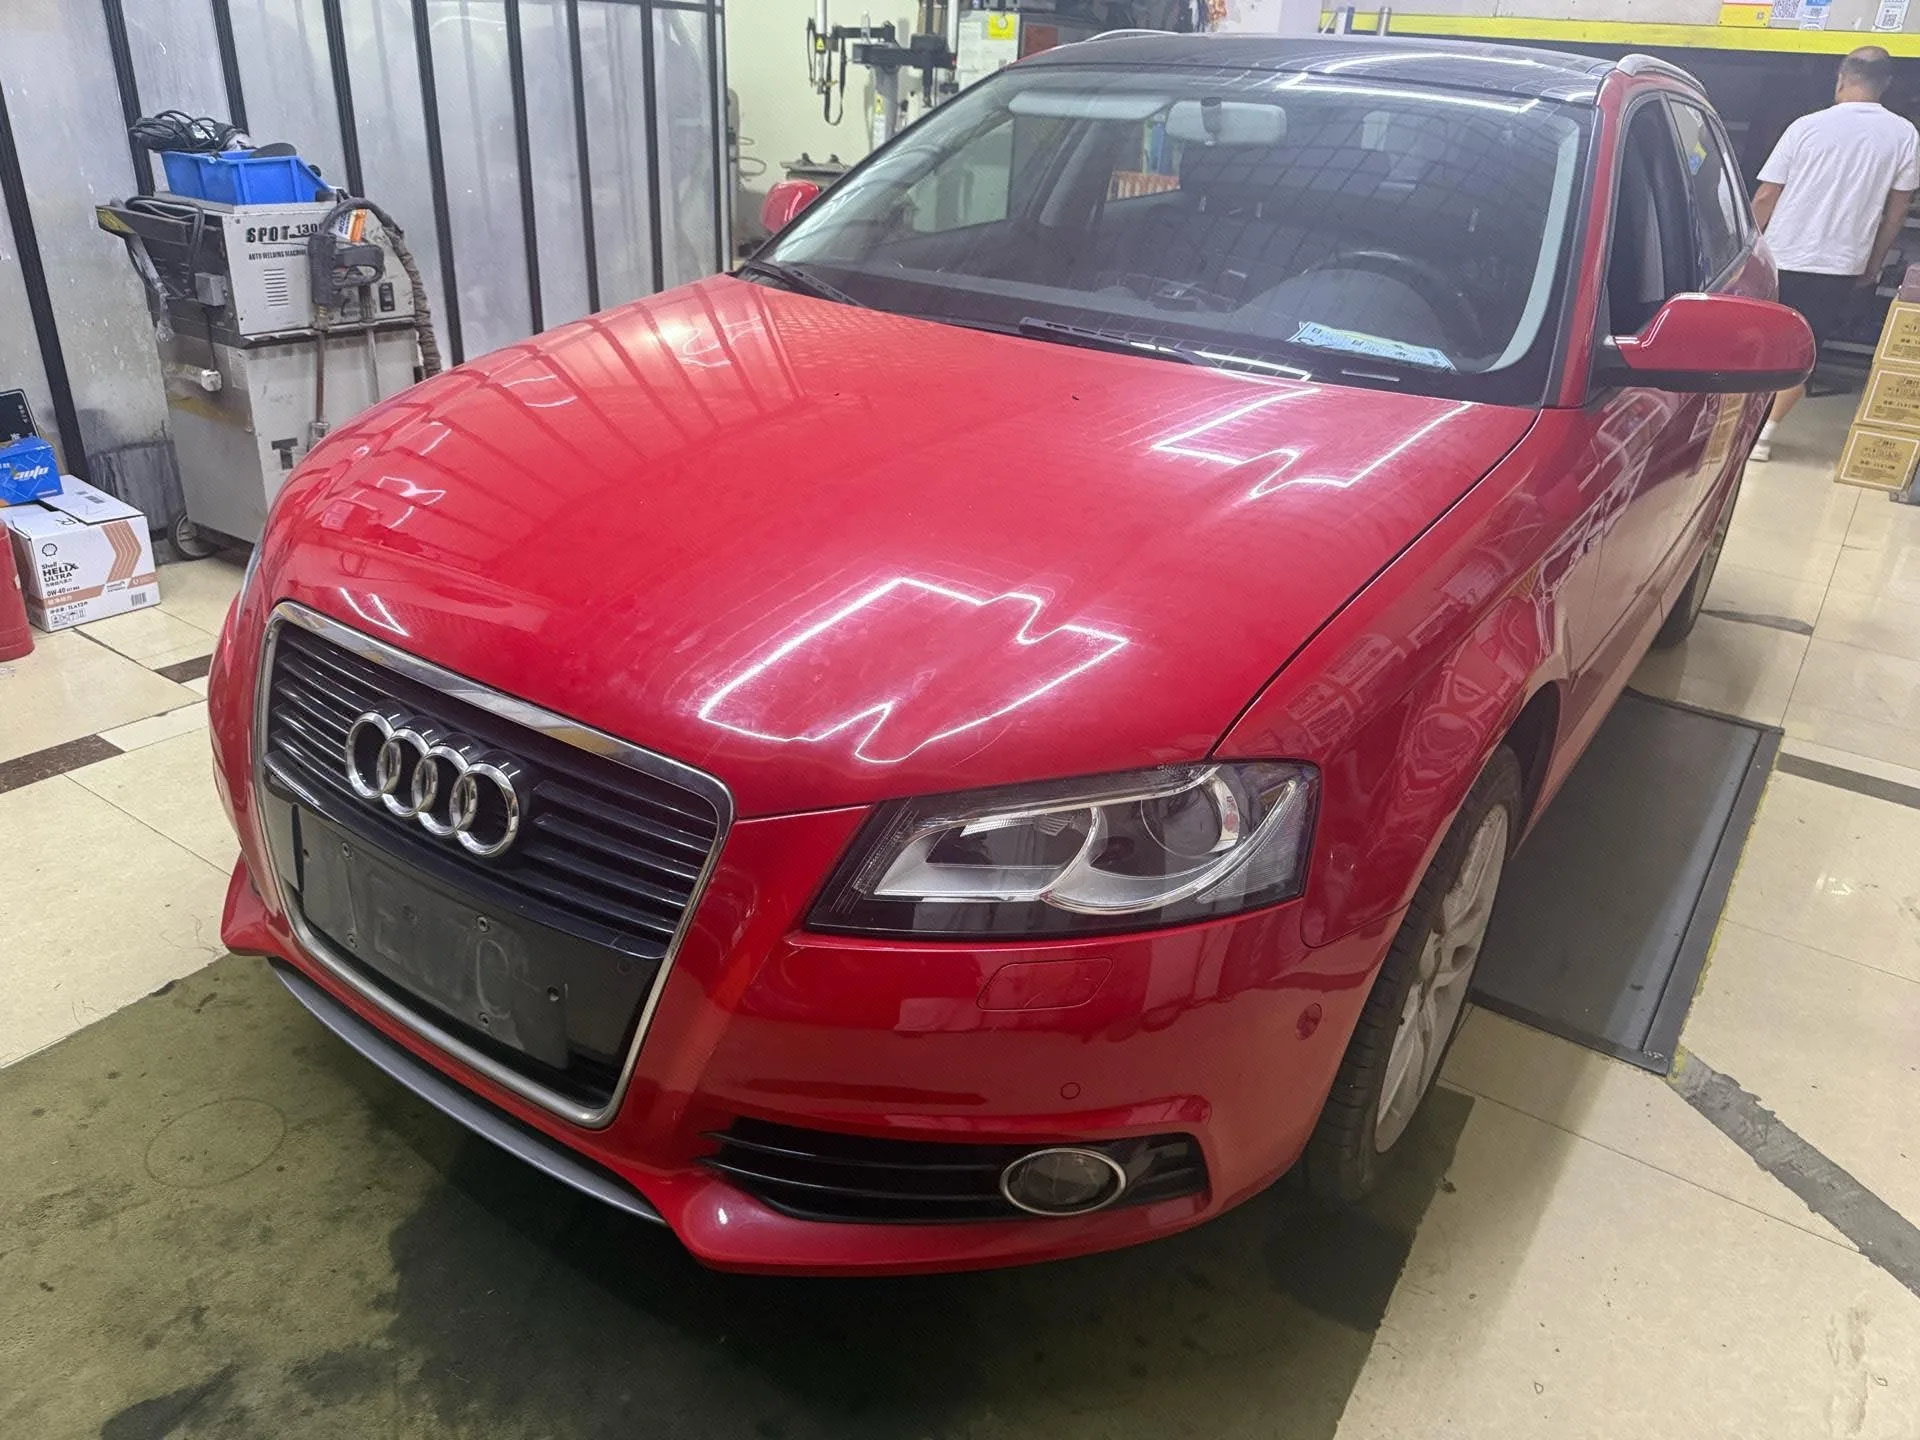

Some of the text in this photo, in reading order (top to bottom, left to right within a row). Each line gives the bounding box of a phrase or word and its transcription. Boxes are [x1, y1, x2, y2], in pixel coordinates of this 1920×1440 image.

[246, 225, 290, 243] SPOT
[249, 252, 262, 261] AUTO
[41, 562, 57, 570] Shell
[42, 563, 80, 577] HELIX
[43, 572, 73, 583] ULTRA
